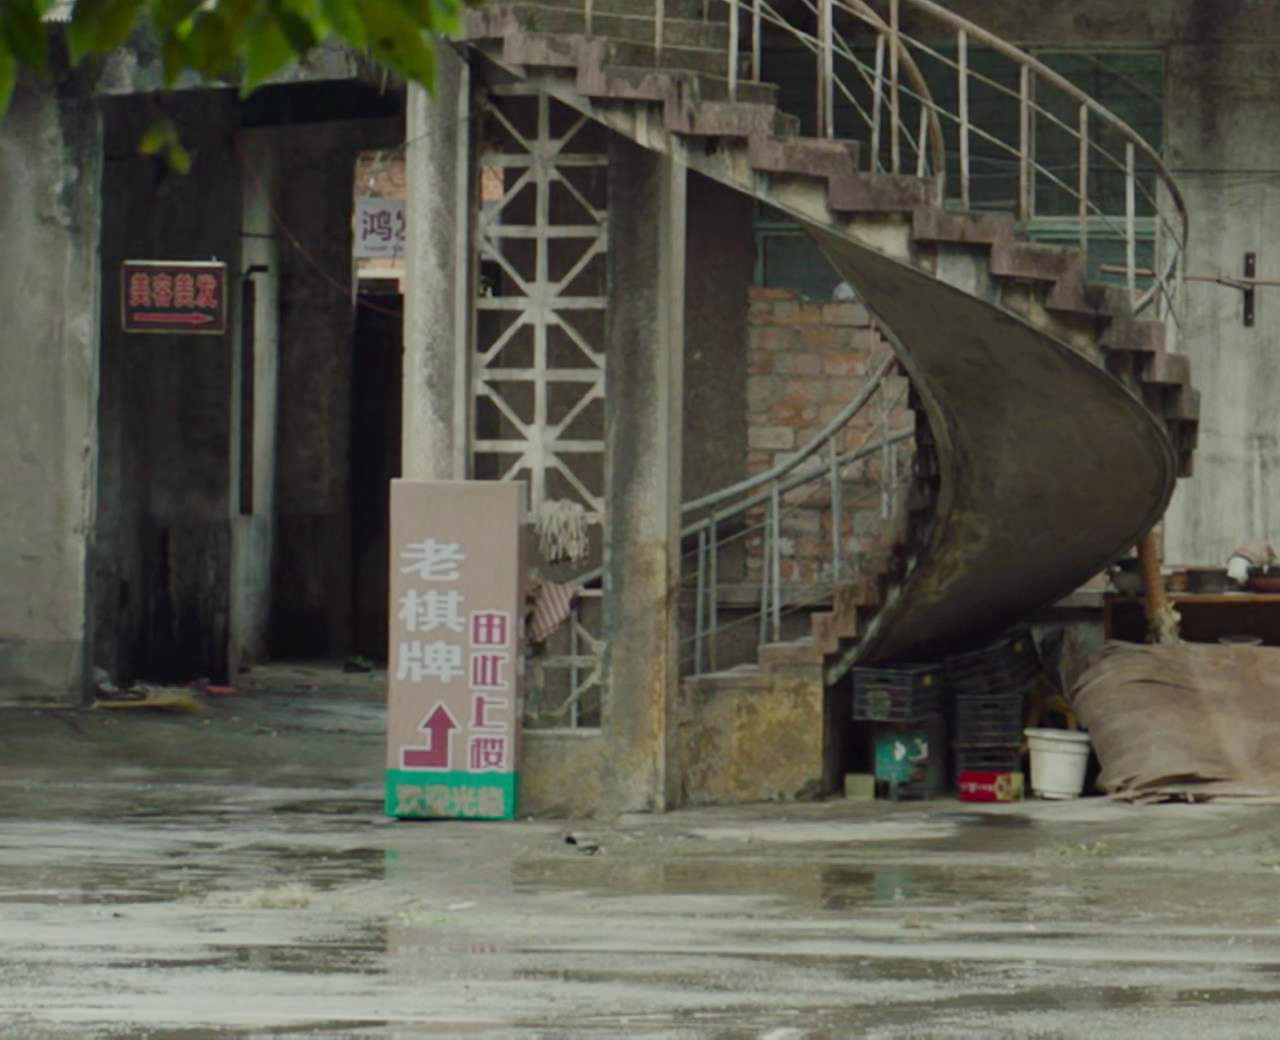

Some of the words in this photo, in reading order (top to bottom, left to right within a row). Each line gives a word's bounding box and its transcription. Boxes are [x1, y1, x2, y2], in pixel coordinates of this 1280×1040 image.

[362, 209, 405, 241] 鸿
[130, 272, 218, 309] 美容美发
[397, 538, 466, 683] 老棋牌
[469, 611, 509, 773] 由此上楼
